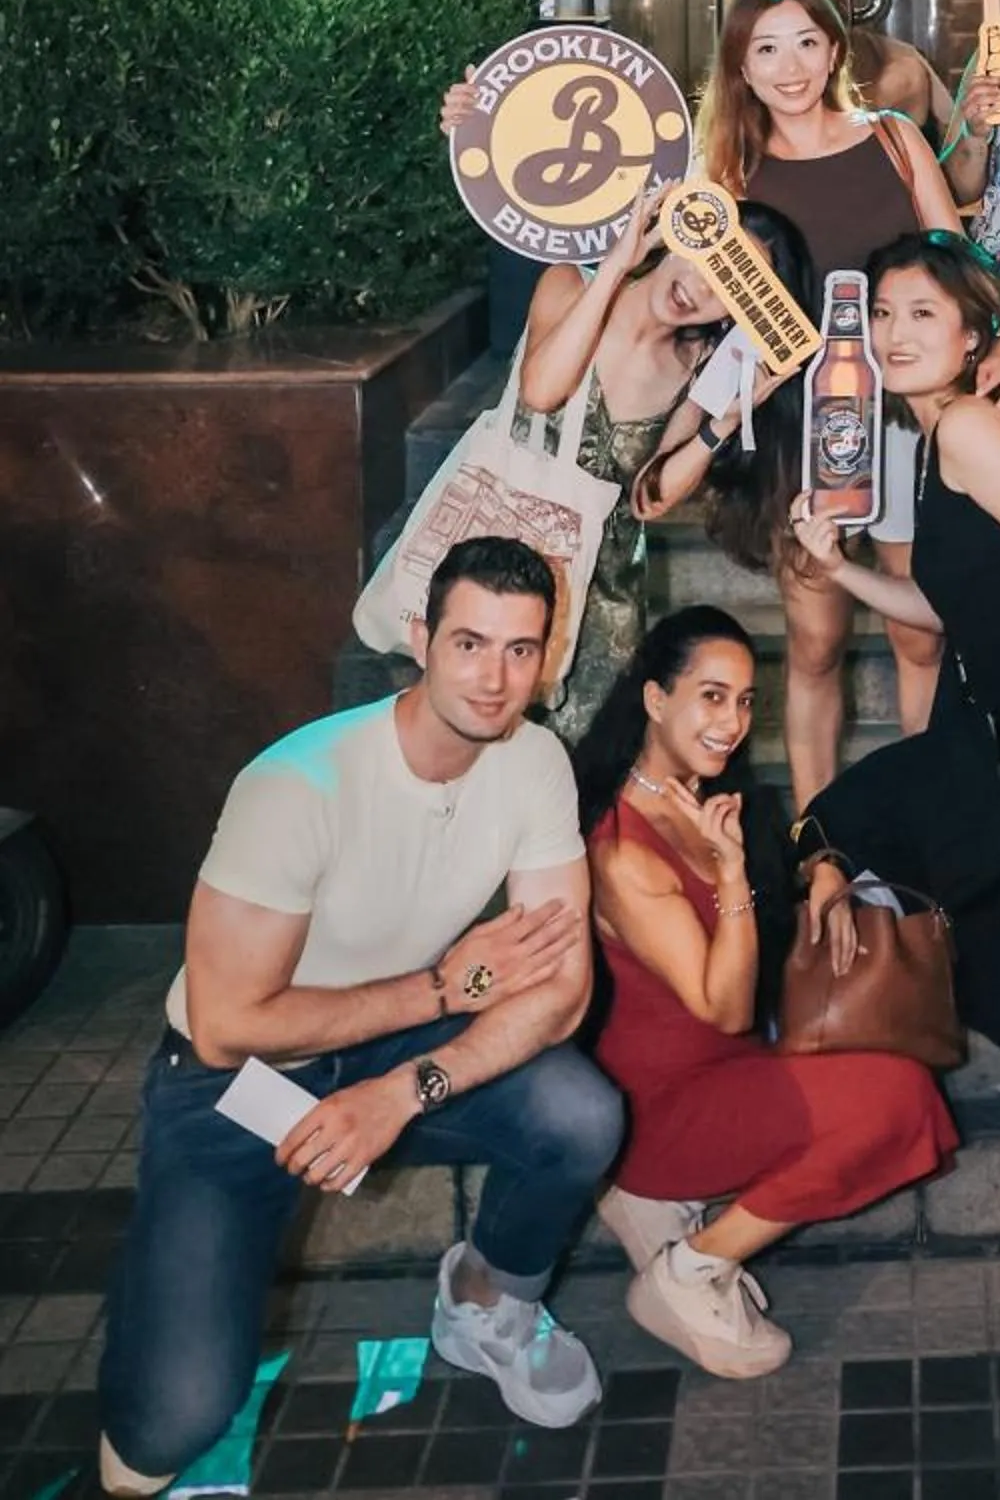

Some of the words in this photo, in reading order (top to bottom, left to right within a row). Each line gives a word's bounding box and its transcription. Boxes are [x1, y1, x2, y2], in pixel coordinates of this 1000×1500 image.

[476, 35, 655, 115] BROOKLYN
[722, 236, 773, 300] BROOKLYN
[763, 295, 811, 349] BREWERY
